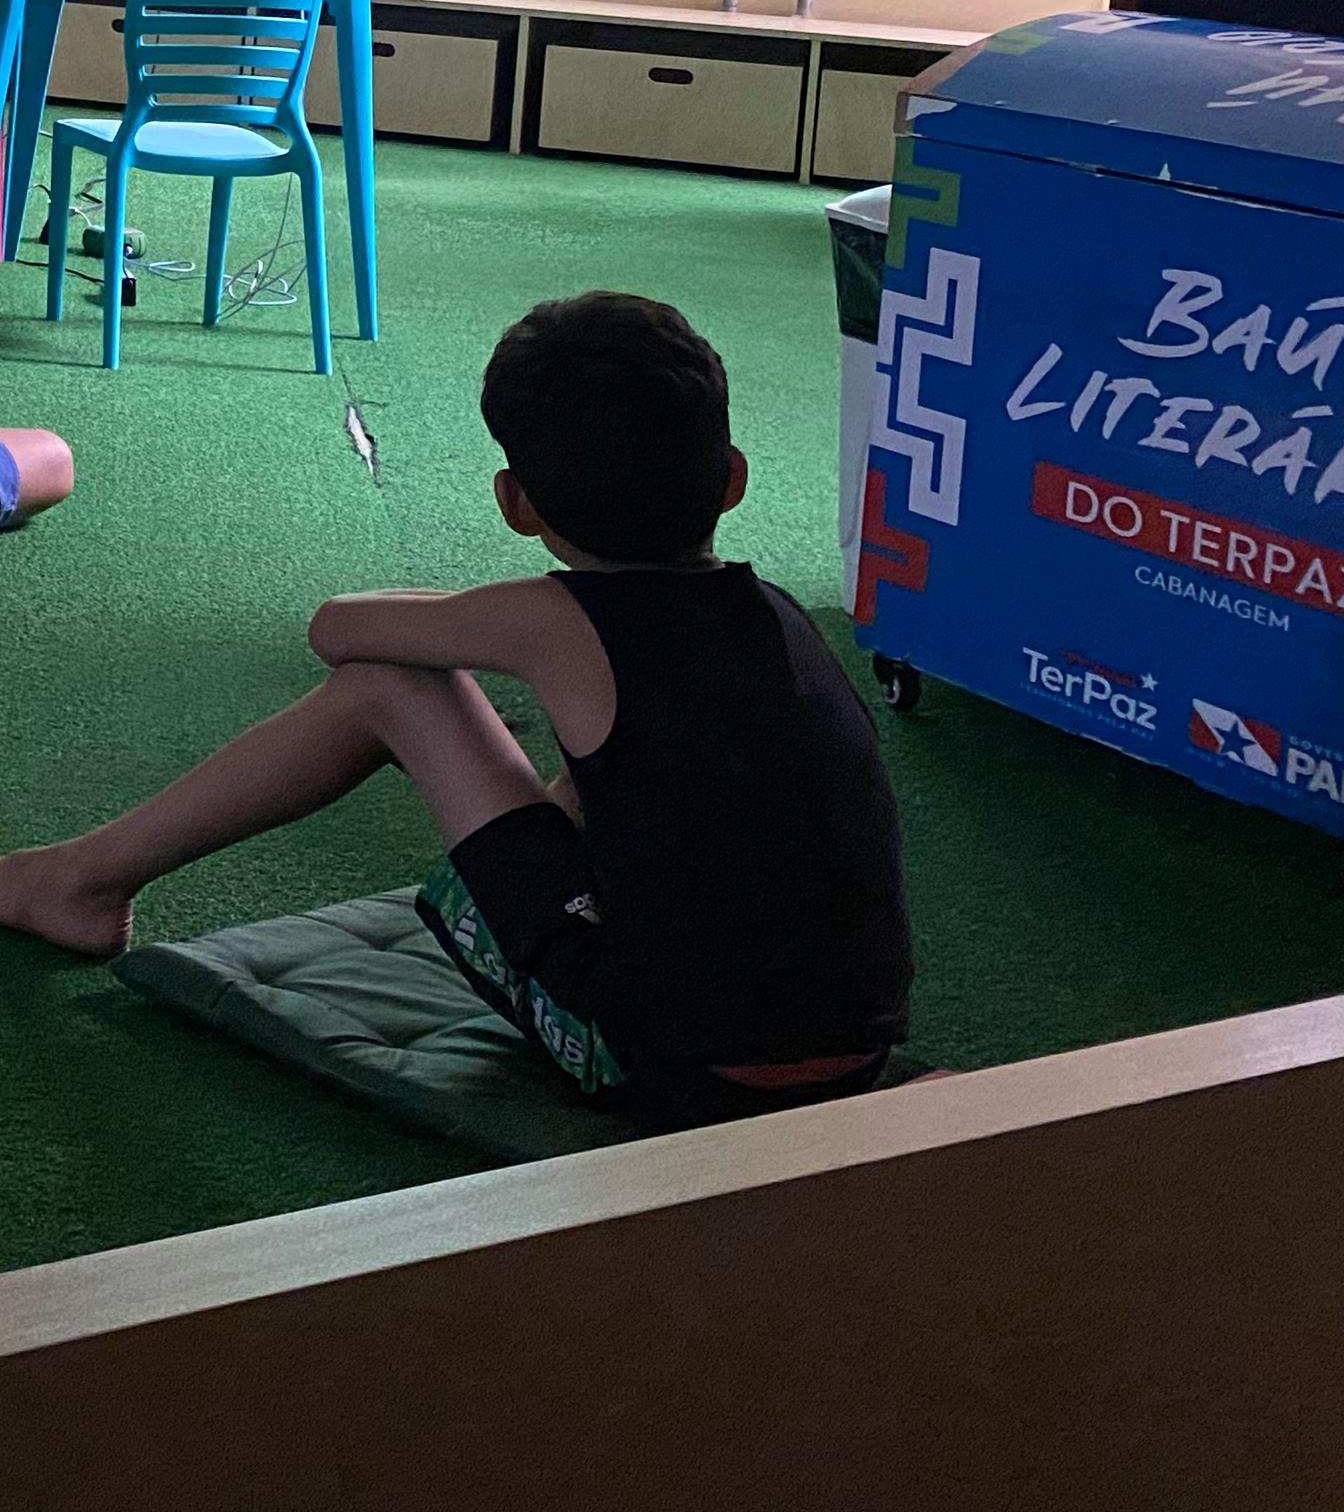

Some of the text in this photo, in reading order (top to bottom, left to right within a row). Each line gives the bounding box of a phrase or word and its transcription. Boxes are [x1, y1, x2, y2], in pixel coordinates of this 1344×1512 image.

[1065, 481, 1344, 609] DO TERPA
[1134, 566, 1290, 632] CABANAGEM
[1022, 646, 1158, 731] TerPaz
